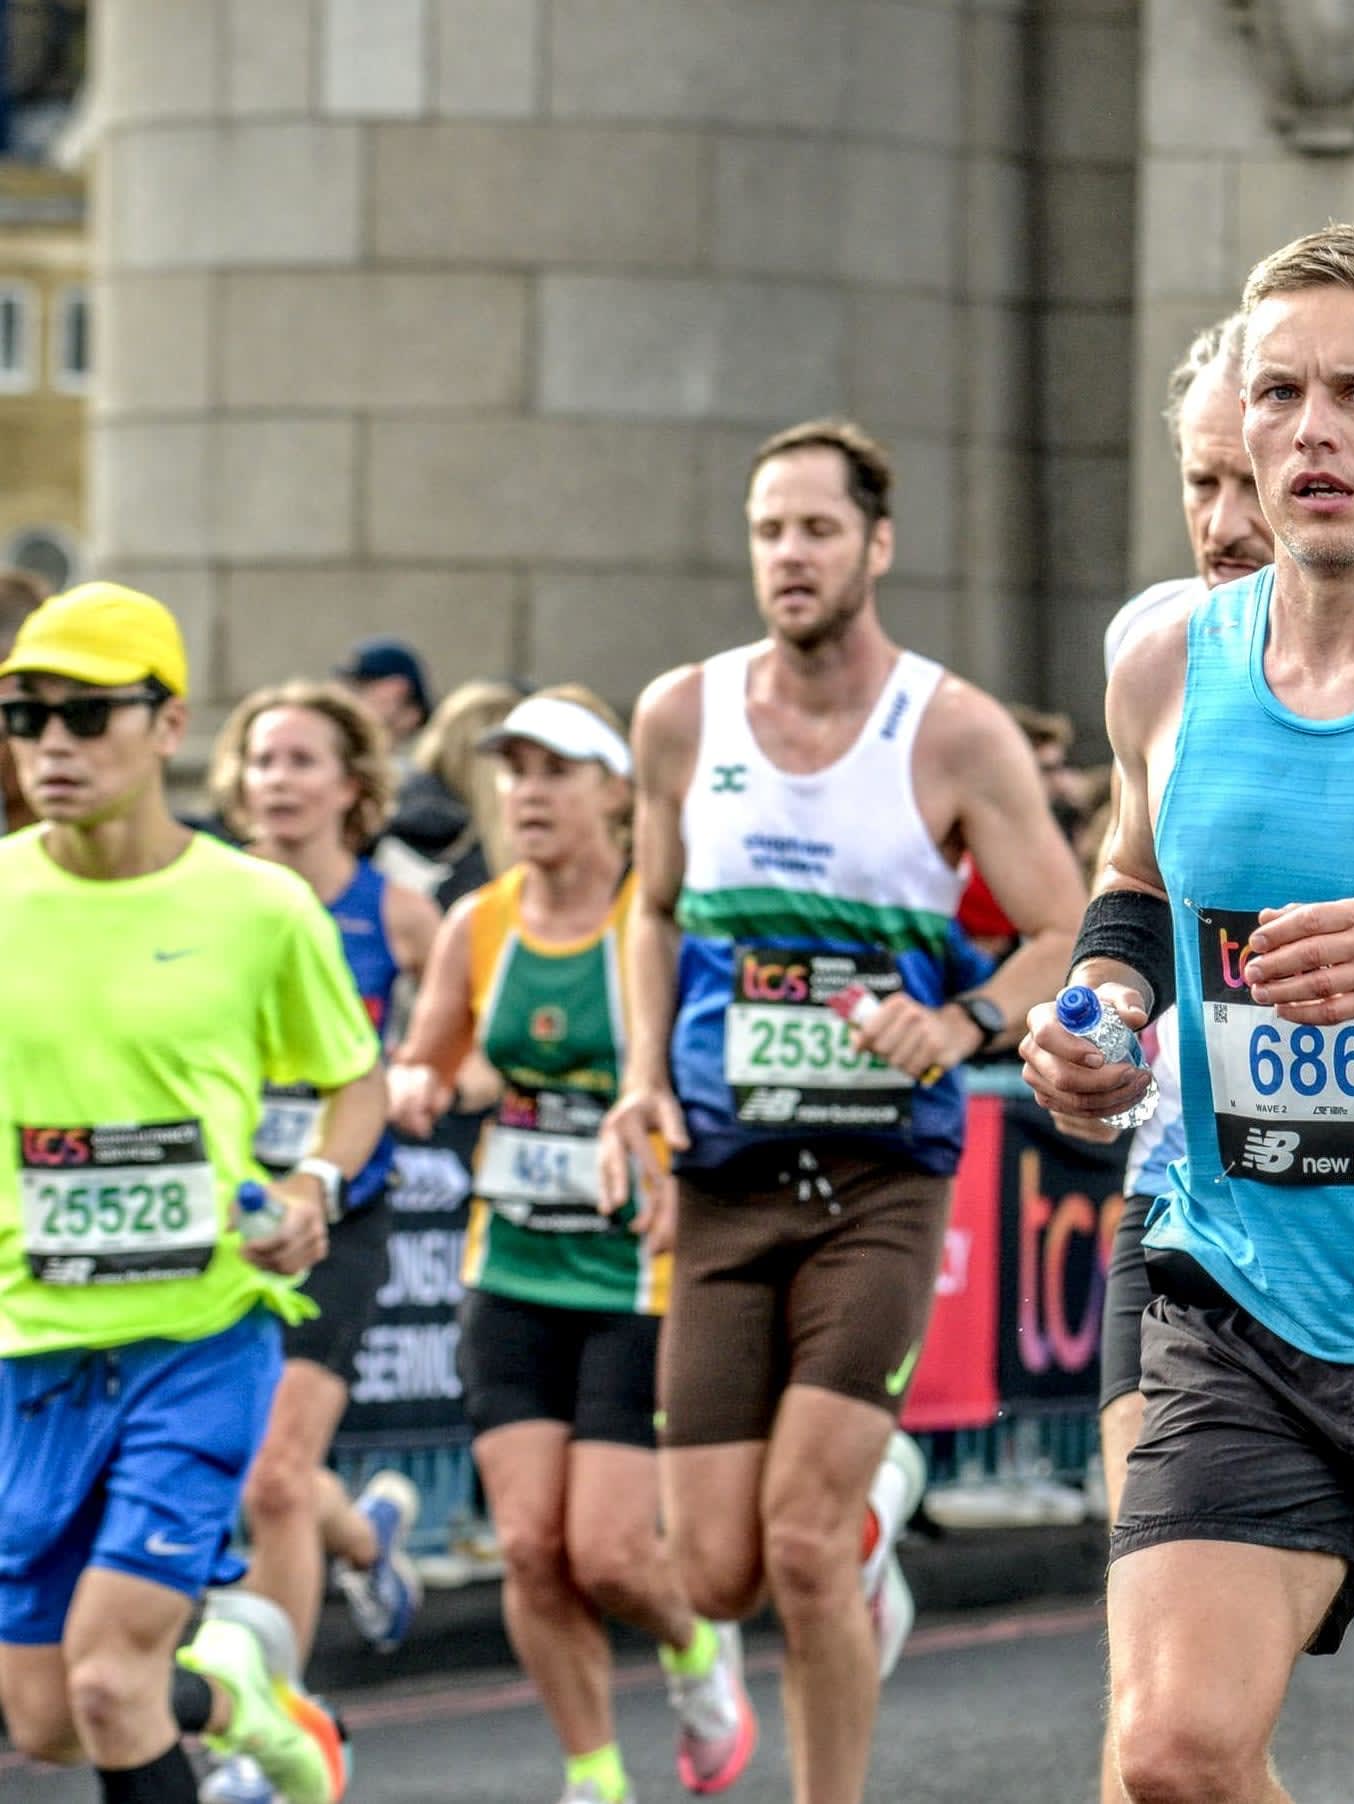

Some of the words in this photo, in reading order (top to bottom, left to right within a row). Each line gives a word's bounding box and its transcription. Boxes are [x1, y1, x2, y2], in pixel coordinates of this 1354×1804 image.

[742, 955, 810, 1001] tcs
[1255, 1103, 1280, 1113] WAVE
[1281, 1105, 1288, 1113] 2
[1302, 1156, 1350, 1174] new
[40, 1182, 189, 1236] 25528
[1019, 1150, 1126, 1370] tc
